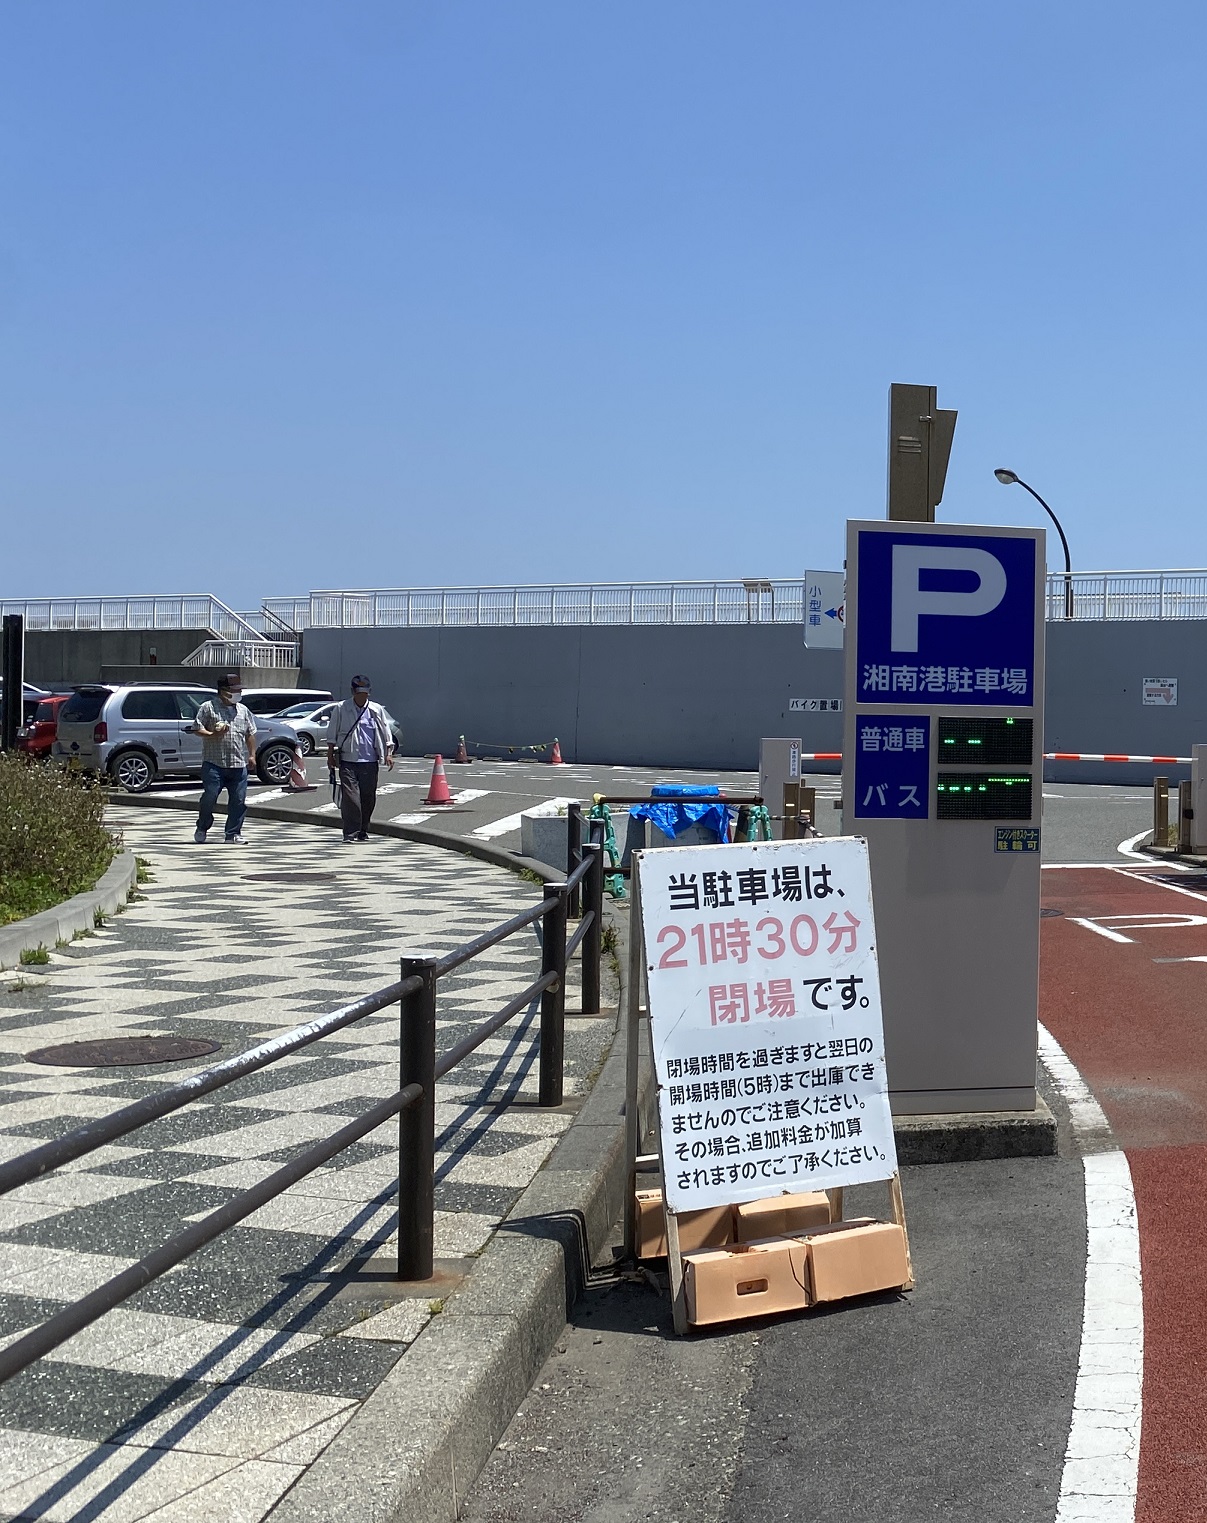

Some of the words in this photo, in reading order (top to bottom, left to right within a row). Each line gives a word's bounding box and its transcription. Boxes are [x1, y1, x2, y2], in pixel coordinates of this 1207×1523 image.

[809, 585, 822, 626] 小型車
[890, 544, 1008, 653] P
[862, 664, 1028, 695] 湘南港駐車場
[860, 726, 926, 753] 普通車
[862, 784, 921, 807] バス
[668, 863, 846, 911] 当駐車場は、
[656, 910, 862, 970] 21時30分
[666, 1037, 874, 1079] 閉場時間を過ぎますと翌日の
[669, 1062, 875, 1106] 開場時間(5時)まで出庫でき
[671, 1094, 866, 1135] ませんのでご注意ください。
[674, 1117, 863, 1162] その場合、追加料金が加算
[677, 1145, 887, 1190] されますのでご了承ください。
